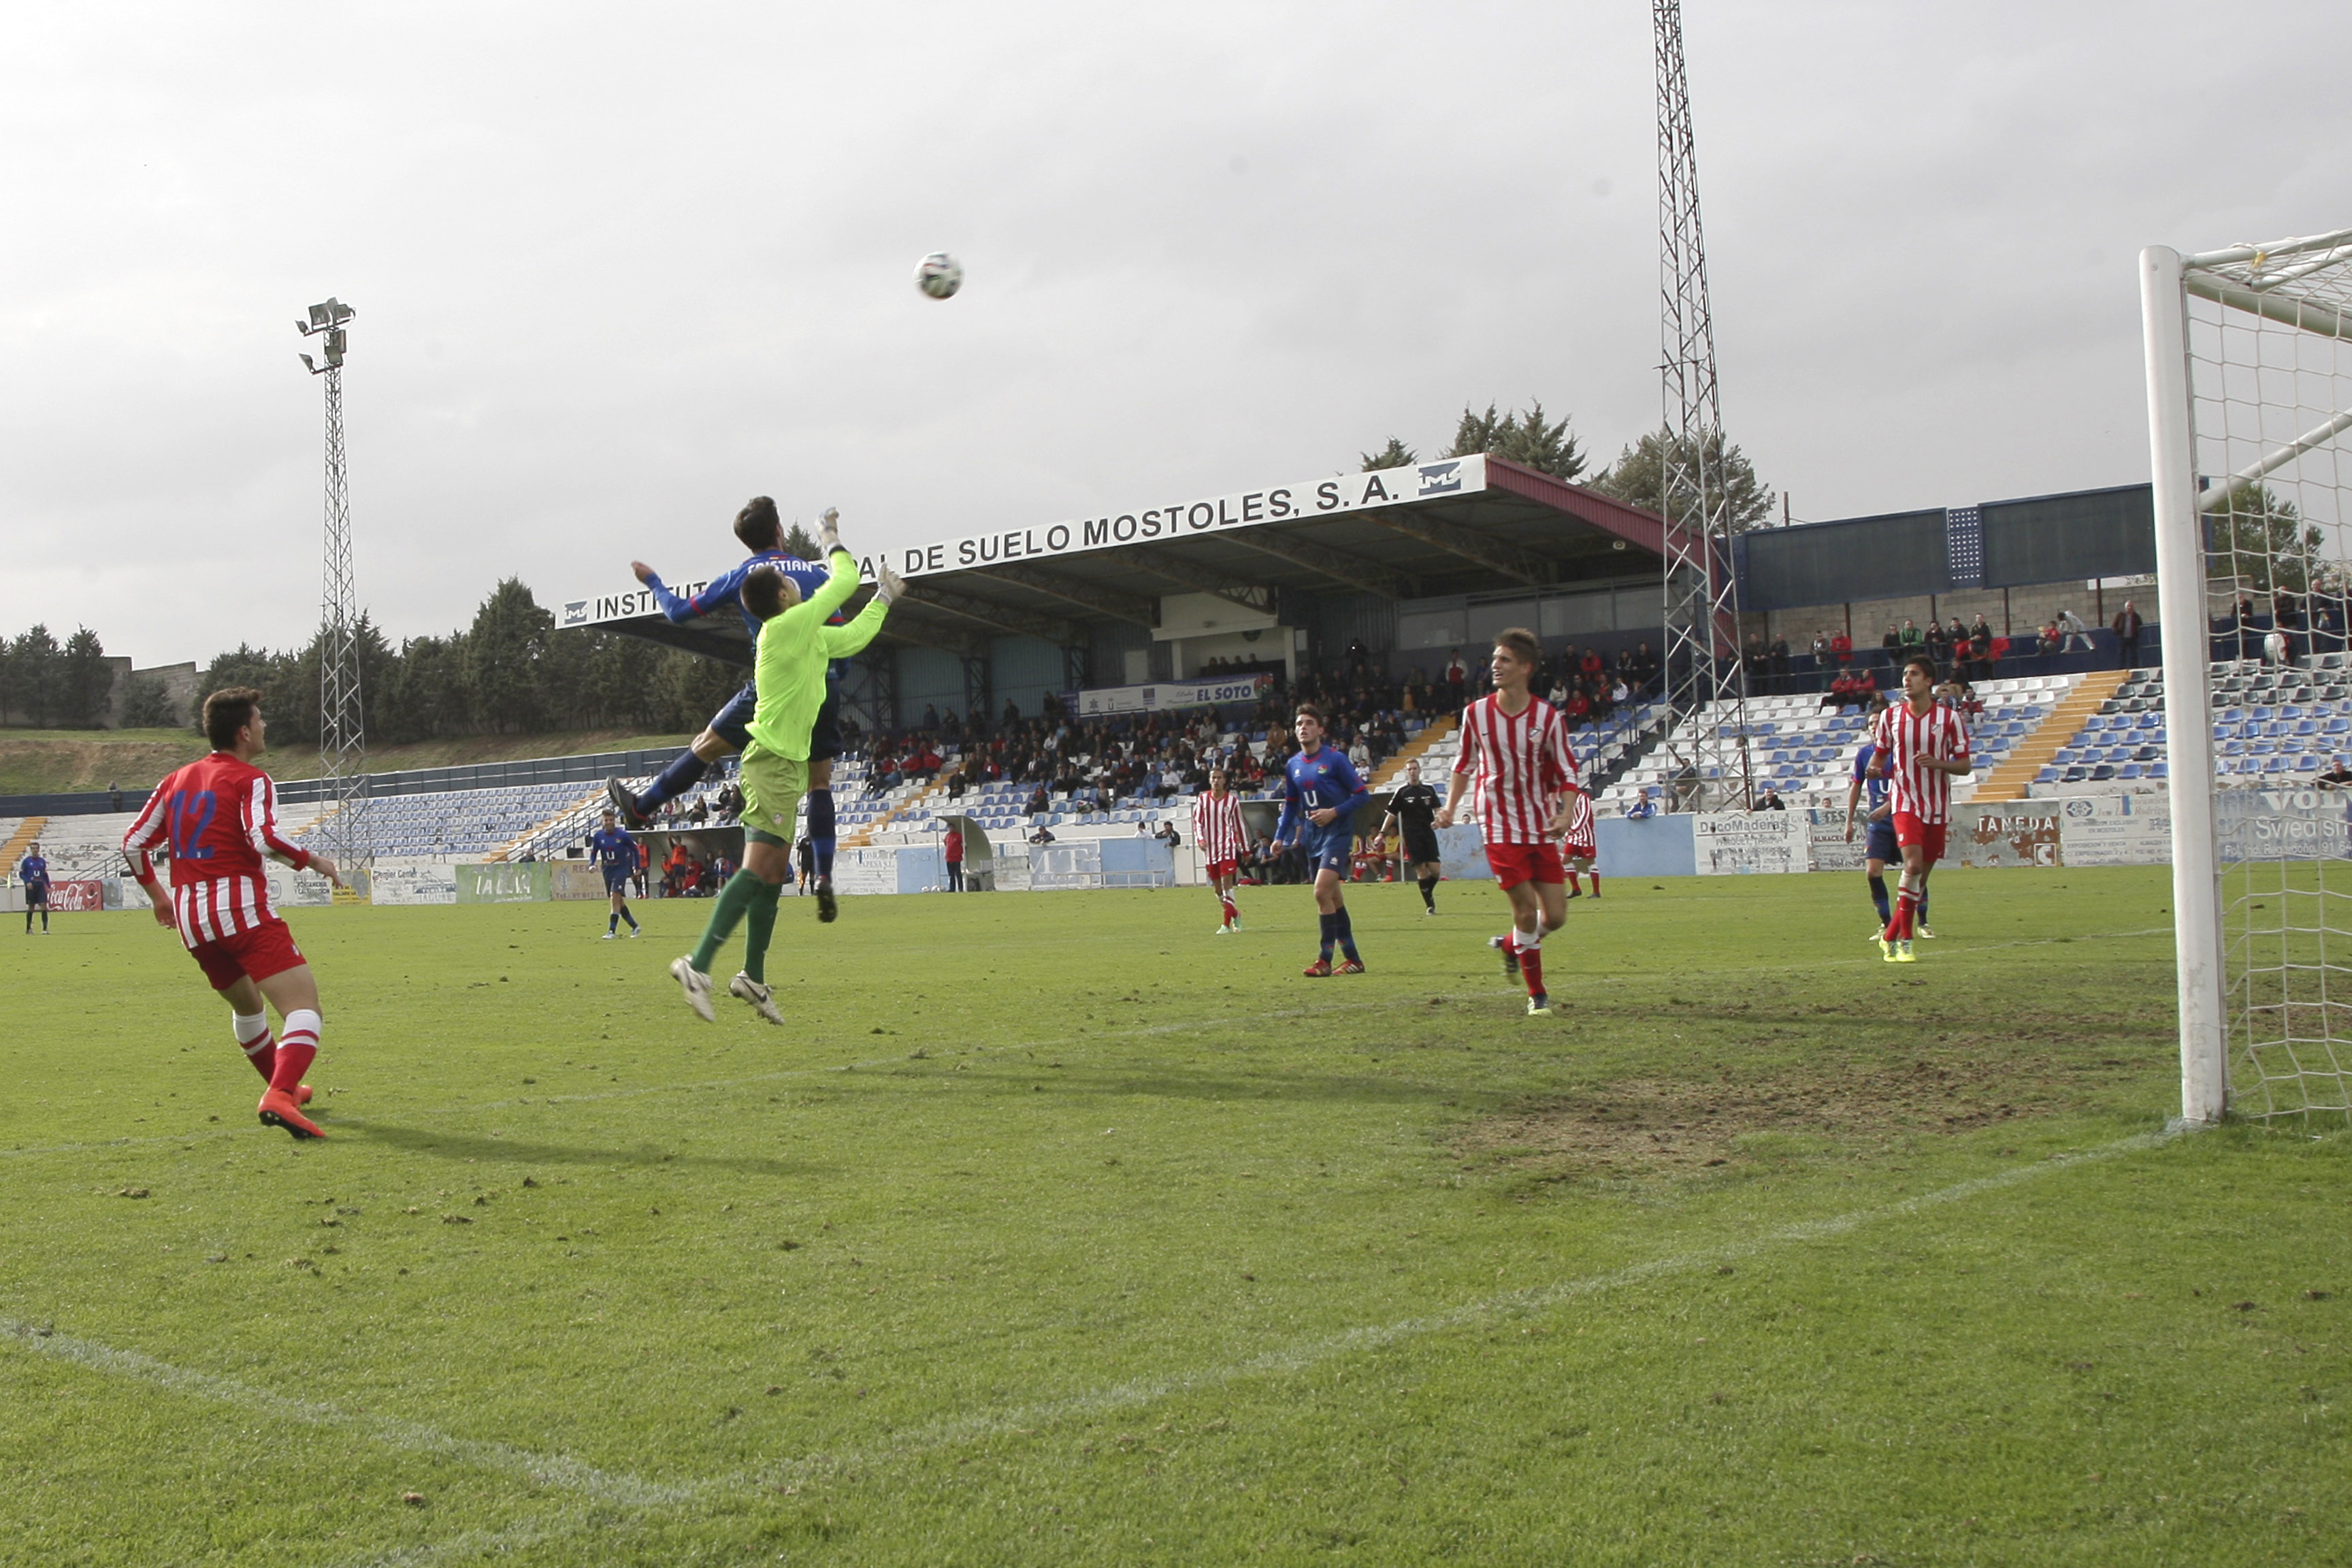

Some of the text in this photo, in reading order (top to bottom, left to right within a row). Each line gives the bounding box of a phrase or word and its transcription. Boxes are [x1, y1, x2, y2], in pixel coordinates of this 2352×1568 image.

[905, 545, 944, 573] DE
[958, 525, 1070, 566] SUELO
[1084, 489, 1300, 545] MOSTOLES,
[749, 560, 812, 586] CSTIAN
[1197, 689, 1211, 702] EL
[1215, 685, 1252, 700] SOTO
[1878, 779, 1893, 794] U
[1304, 790, 1318, 807] U
[2259, 791, 2352, 811] VOL
[169, 789, 214, 859] 12
[2256, 813, 2348, 839] Swedsh
